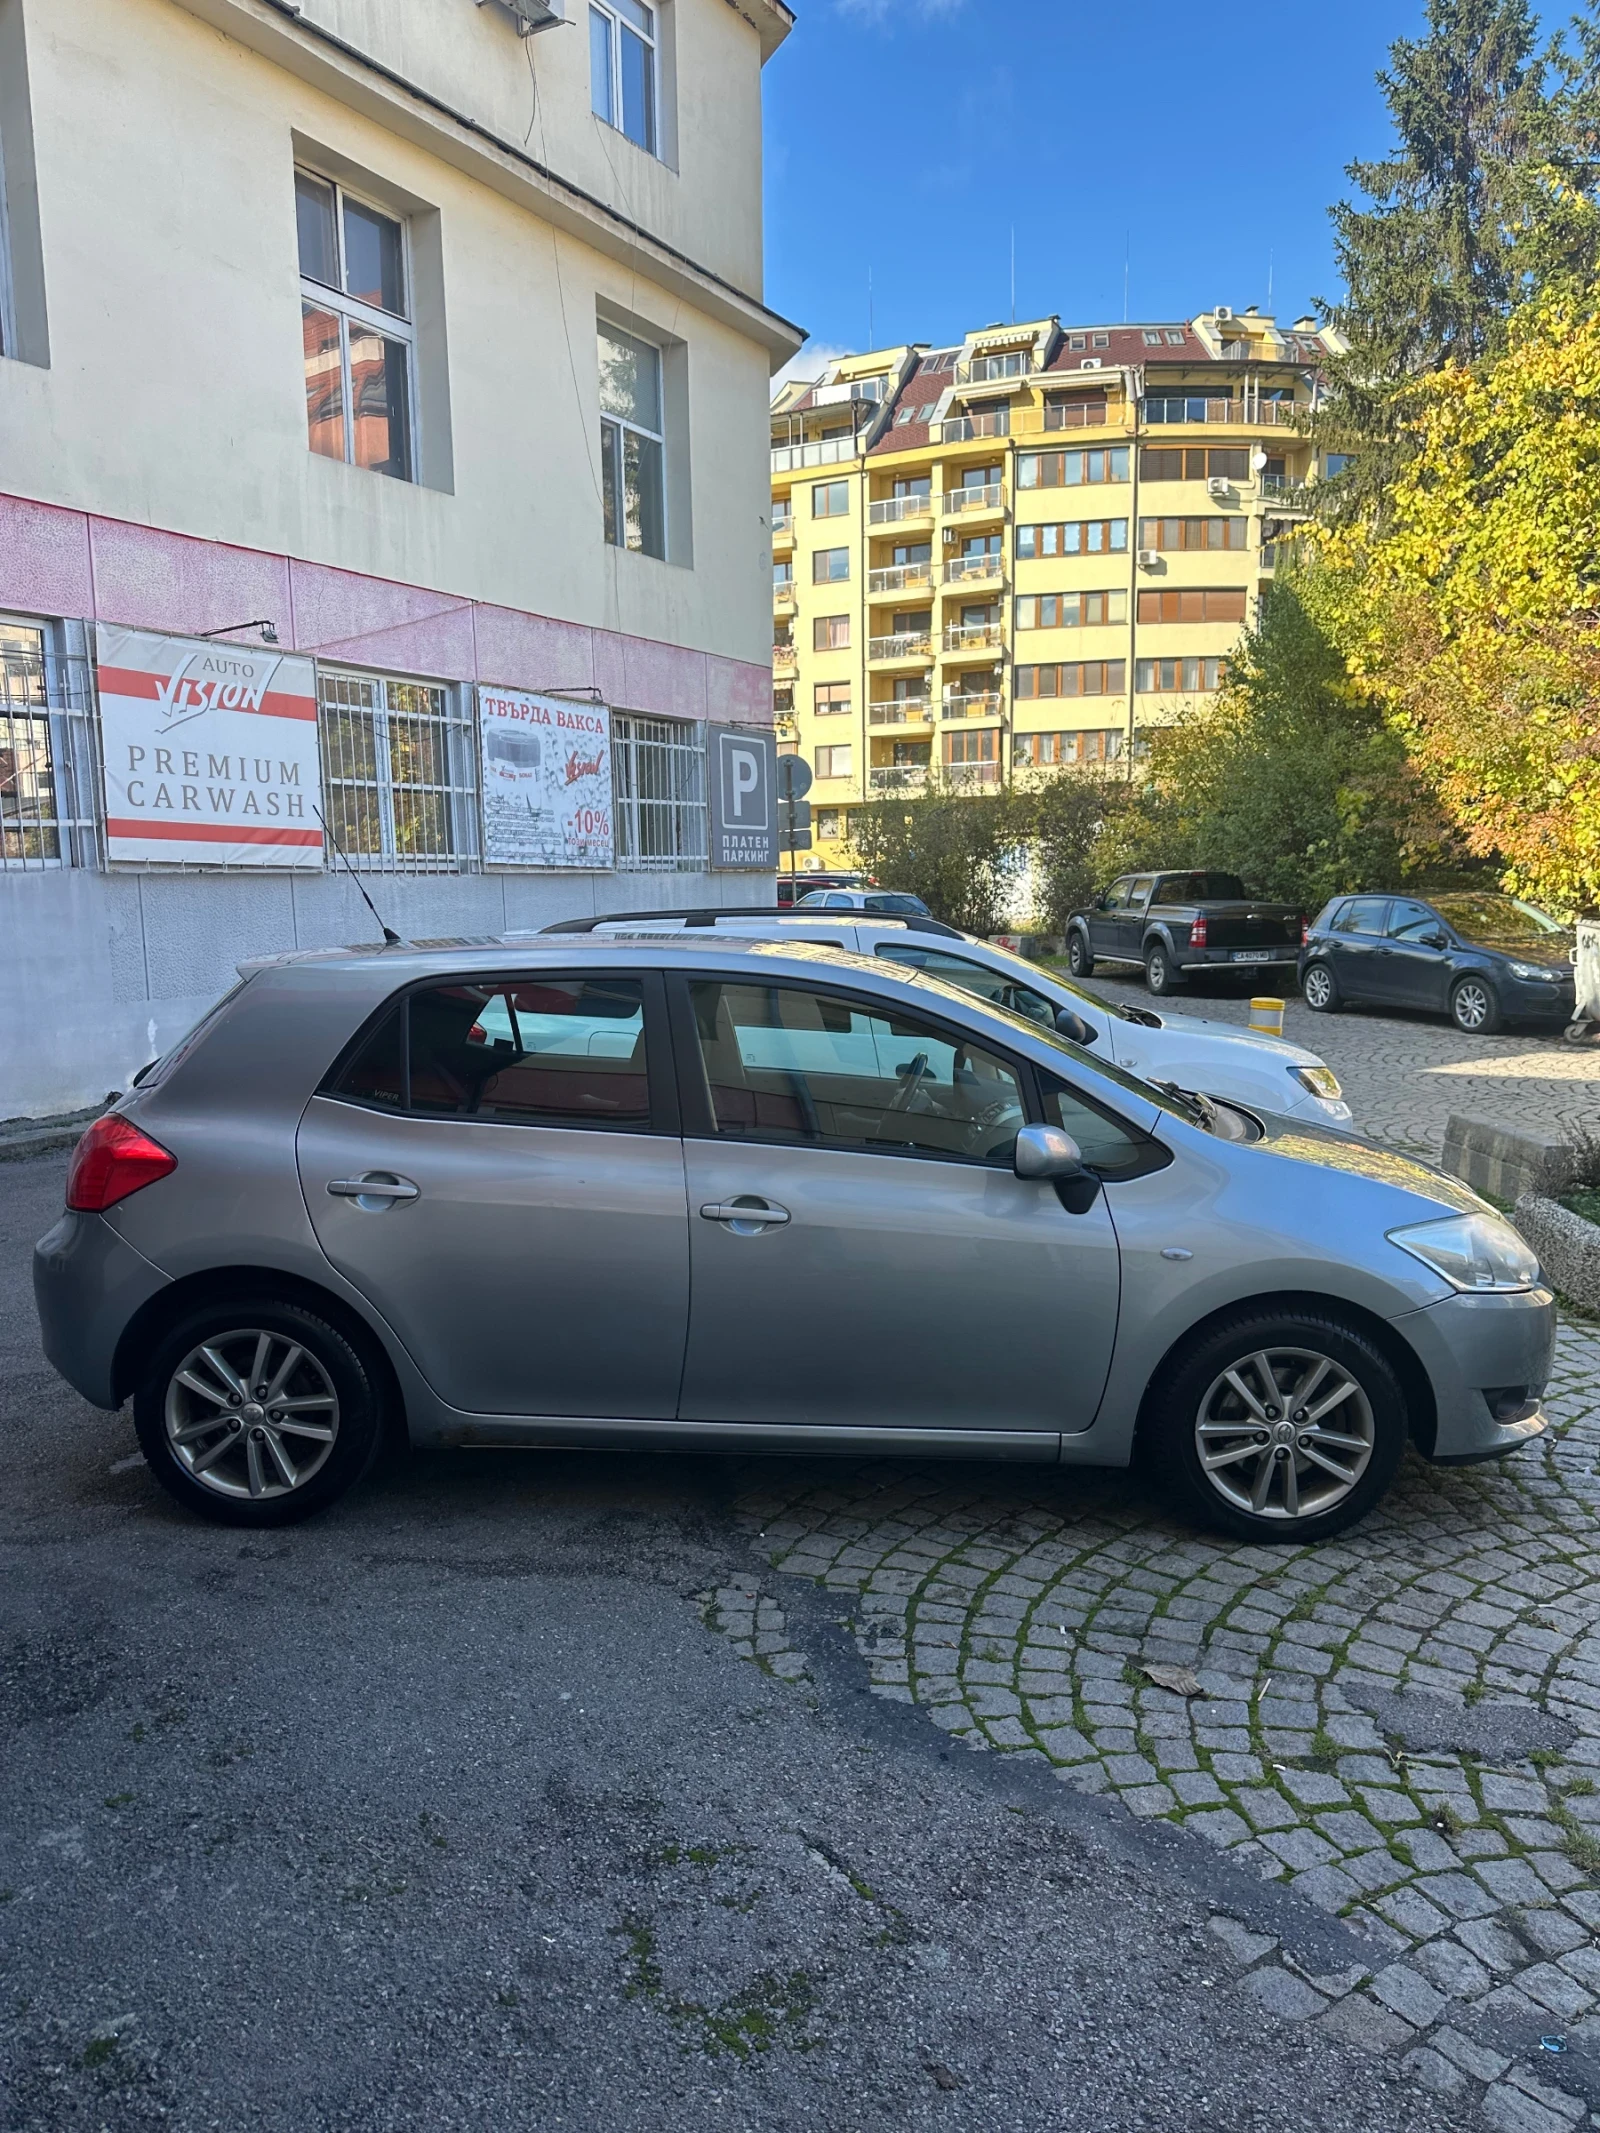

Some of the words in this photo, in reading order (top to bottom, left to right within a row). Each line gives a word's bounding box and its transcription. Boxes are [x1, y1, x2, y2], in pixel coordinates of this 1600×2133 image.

[202, 657, 254, 678] AUTO
[154, 652, 284, 734] VISION
[485, 697, 552, 725] ТВЪРДА
[556, 710, 604, 734] ВАКСА
[127, 745, 301, 786] PREMIUM
[731, 749, 758, 817] P
[127, 780, 305, 818] CARWASH
[722, 835, 769, 849] ПЛАТЕН
[723, 849, 769, 863] ПАРКИНГ
[374, 1089, 399, 1101] VIPER
